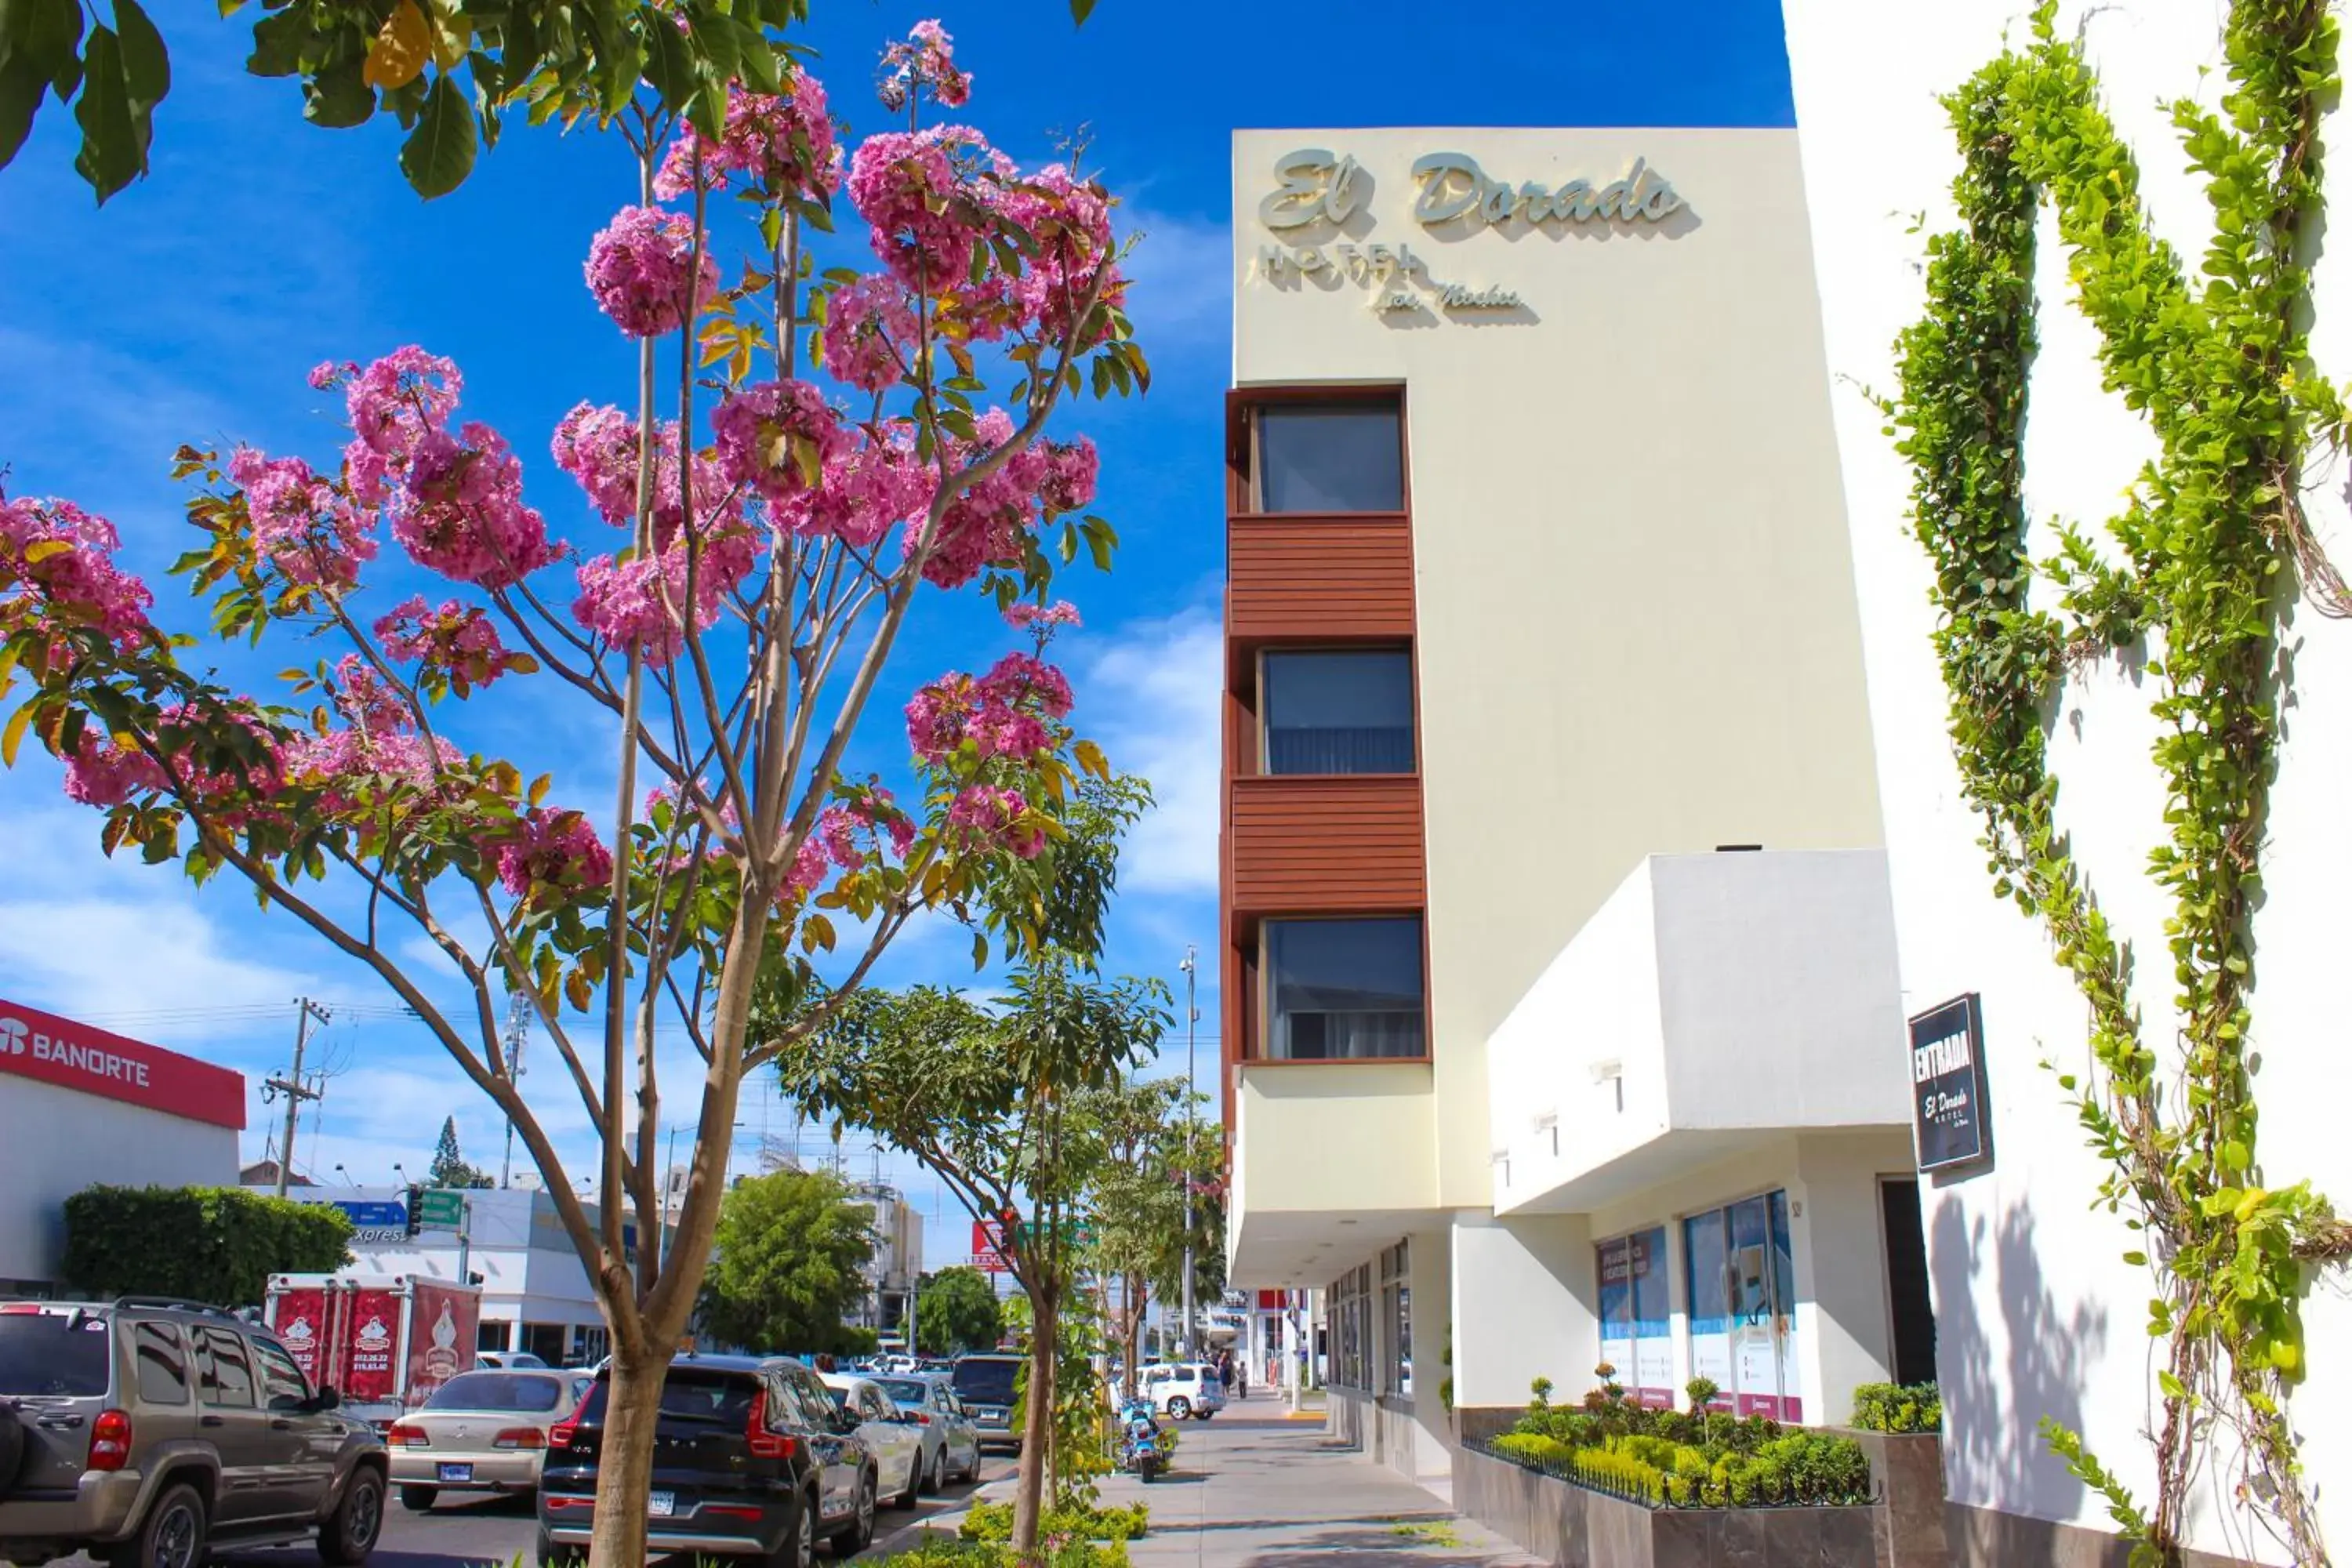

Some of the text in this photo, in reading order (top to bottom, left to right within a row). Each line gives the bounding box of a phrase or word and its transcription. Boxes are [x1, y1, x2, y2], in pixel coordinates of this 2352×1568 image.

[1258, 148, 1683, 230] El Dorado
[1258, 242, 1417, 272] HOTEL
[33, 1033, 150, 1087] BANORTE
[1915, 1030, 1970, 1083] ENTRADA
[1925, 1088, 1966, 1119] El Dorado
[354, 1229, 408, 1243] xpress
